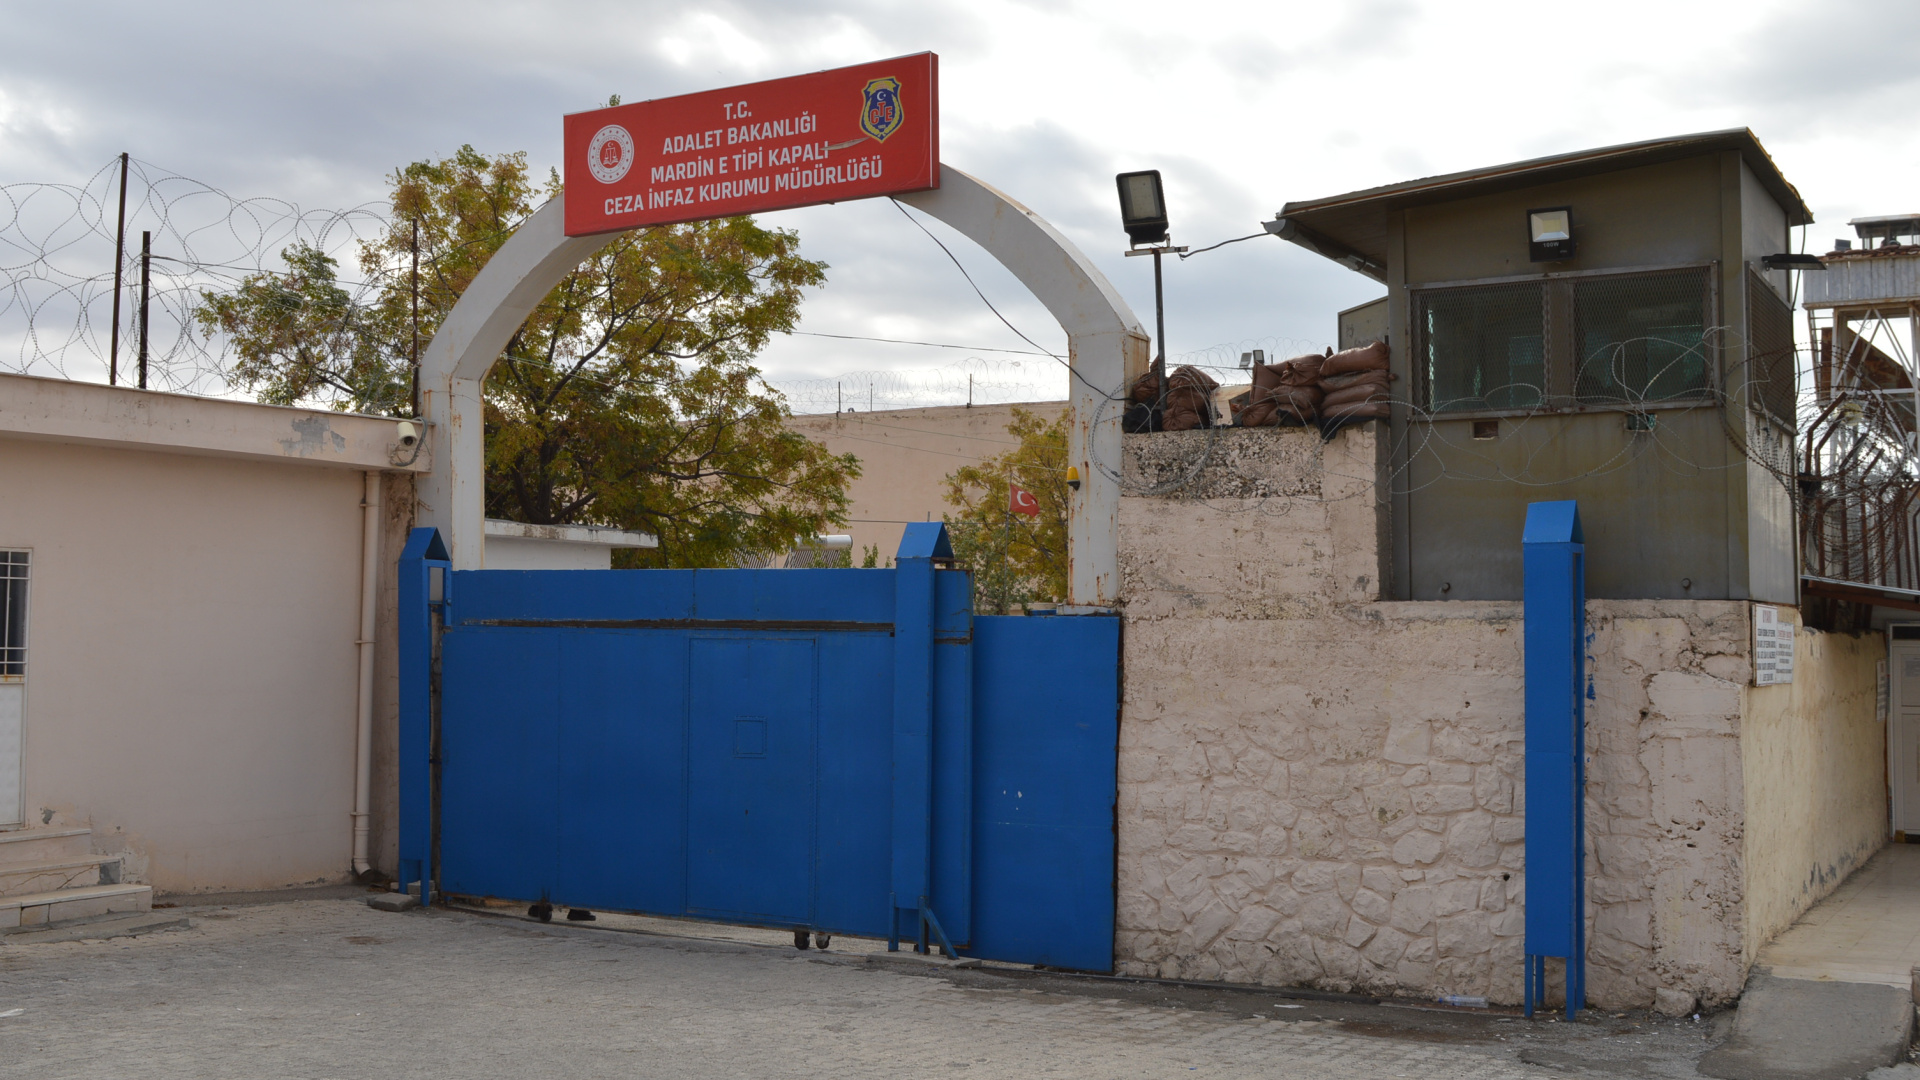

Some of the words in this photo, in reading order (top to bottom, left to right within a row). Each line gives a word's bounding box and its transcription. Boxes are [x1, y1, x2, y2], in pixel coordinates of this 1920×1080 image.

[724, 101, 751, 120] T.C.
[870, 101, 893, 125] CTE
[663, 130, 722, 154] ADALET
[728, 111, 816, 144] BAKANLIĞI
[652, 156, 714, 184] MARDİN
[720, 157, 728, 174] E
[733, 147, 763, 171] TİPİ
[769, 141, 829, 166] KAPALI
[605, 194, 644, 215] CEZA
[648, 187, 695, 209] İNFAZ
[700, 176, 770, 202] KURUMU
[776, 154, 882, 191] MÜDÜRLÜĞÜ
